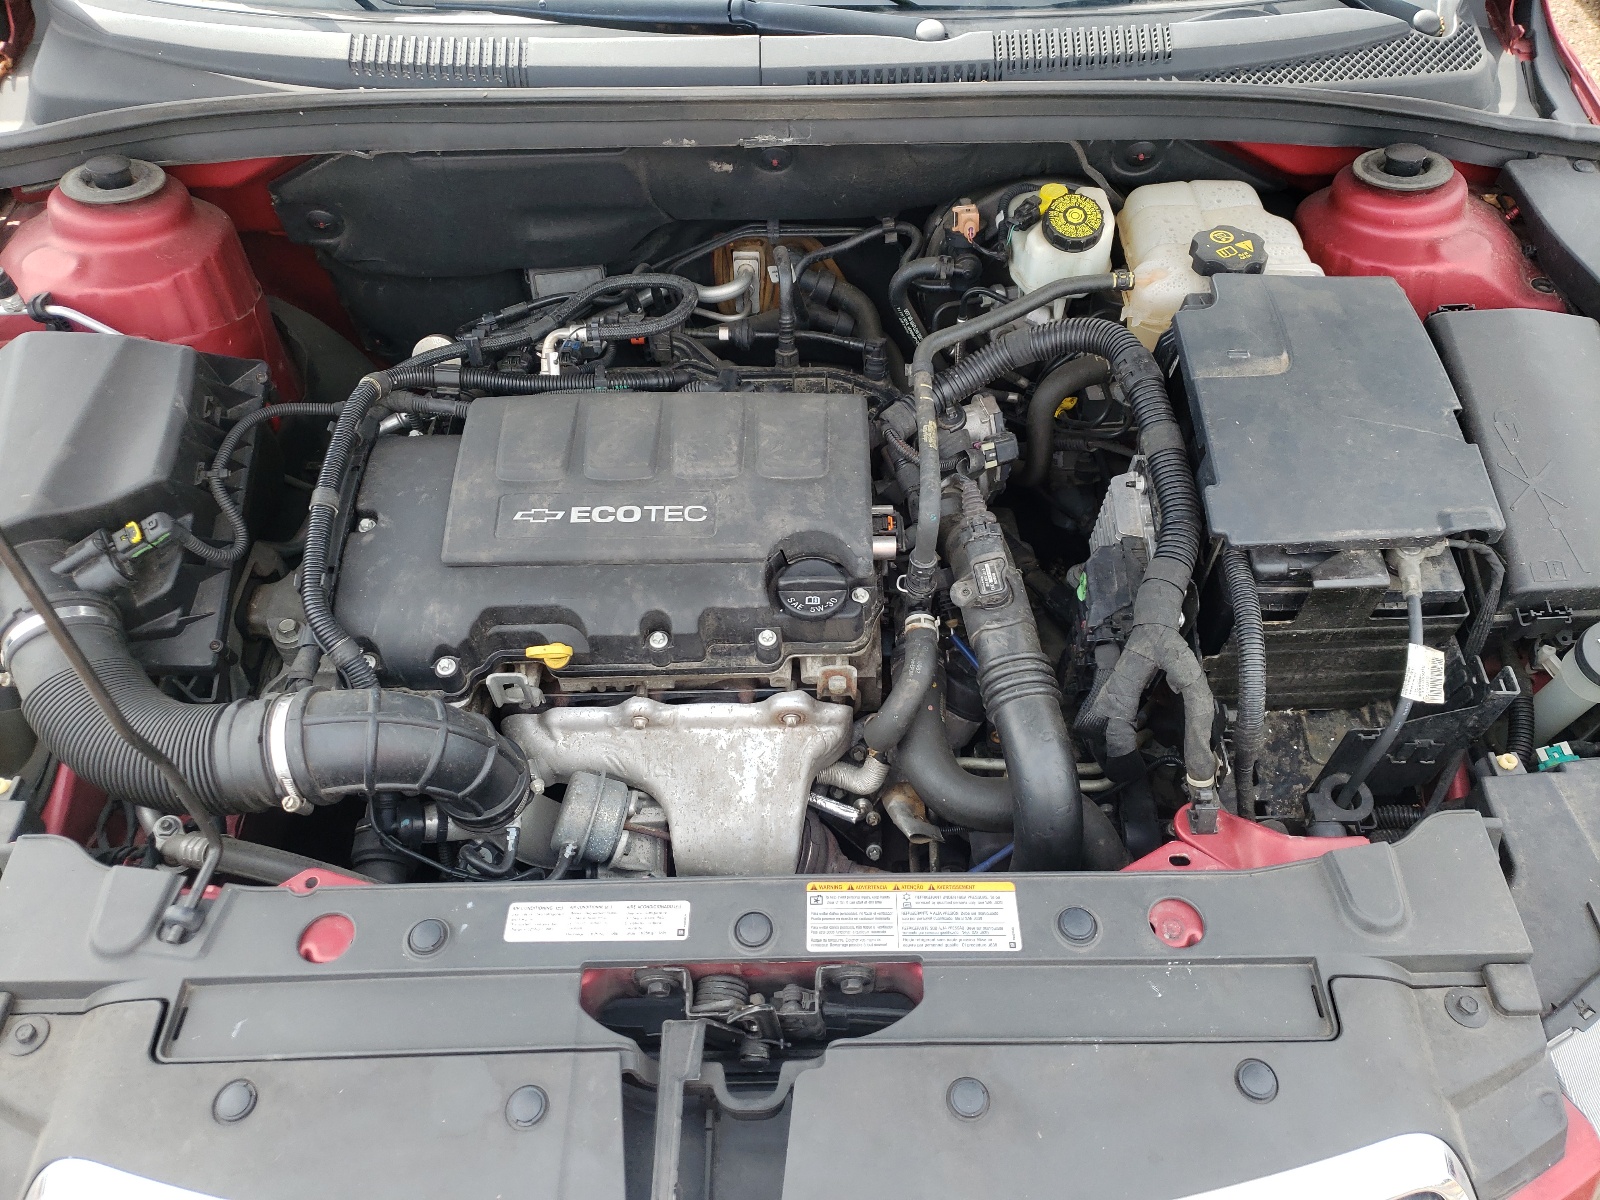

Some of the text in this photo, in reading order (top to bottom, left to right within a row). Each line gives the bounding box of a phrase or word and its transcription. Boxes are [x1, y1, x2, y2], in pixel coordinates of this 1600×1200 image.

[570, 506, 708, 523] ECOTEC
[787, 597, 838, 613] SAE 5W-30
